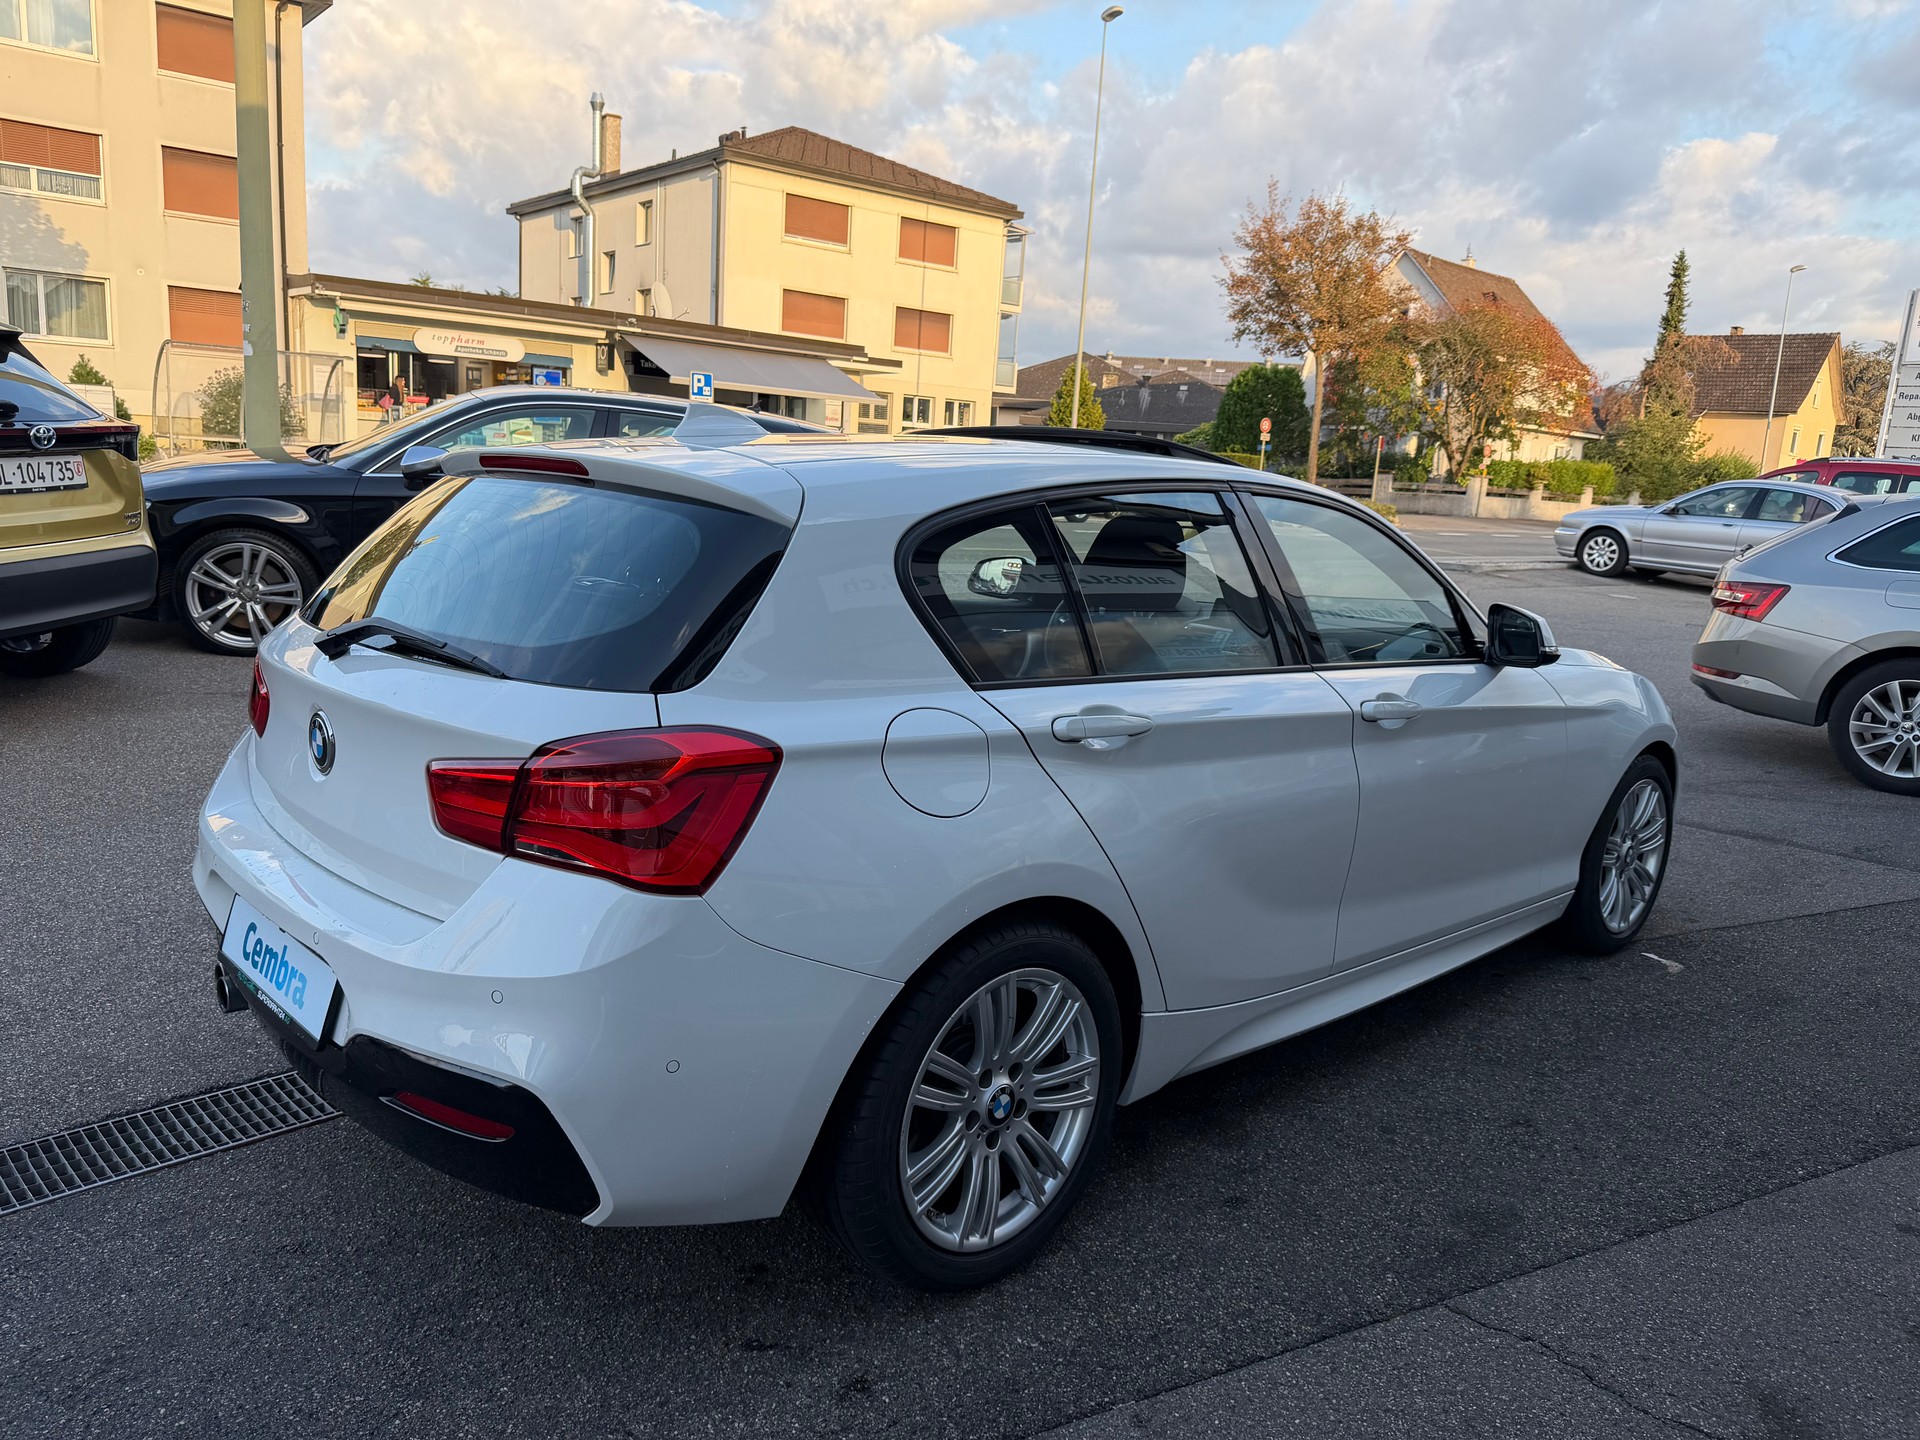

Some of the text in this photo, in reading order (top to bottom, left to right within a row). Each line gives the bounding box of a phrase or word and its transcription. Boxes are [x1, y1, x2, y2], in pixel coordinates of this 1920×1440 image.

[432, 334, 485, 346] toppharm
[693, 375, 704, 393] P
[242, 922, 307, 1009] Cembra
